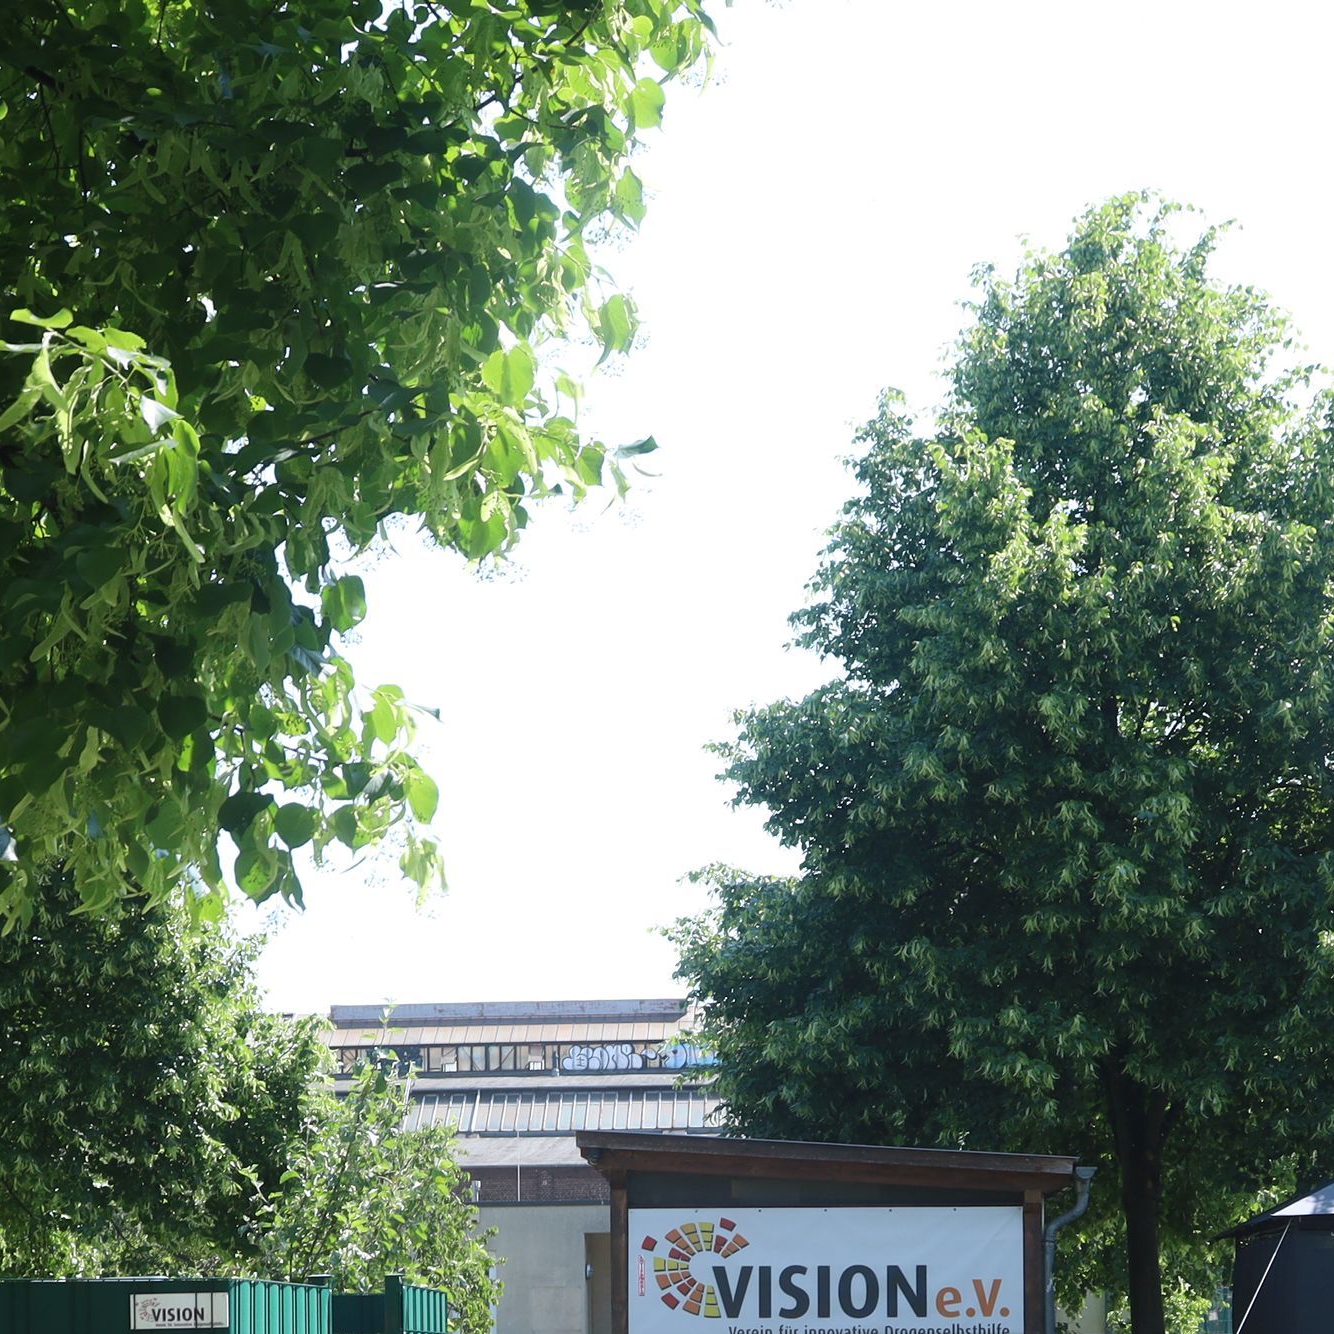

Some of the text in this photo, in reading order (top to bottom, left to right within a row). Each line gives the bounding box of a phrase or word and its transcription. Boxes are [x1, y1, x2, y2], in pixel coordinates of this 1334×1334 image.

[712, 1264, 1011, 1319] VISION e.V.
[151, 1307, 205, 1322] VISION
